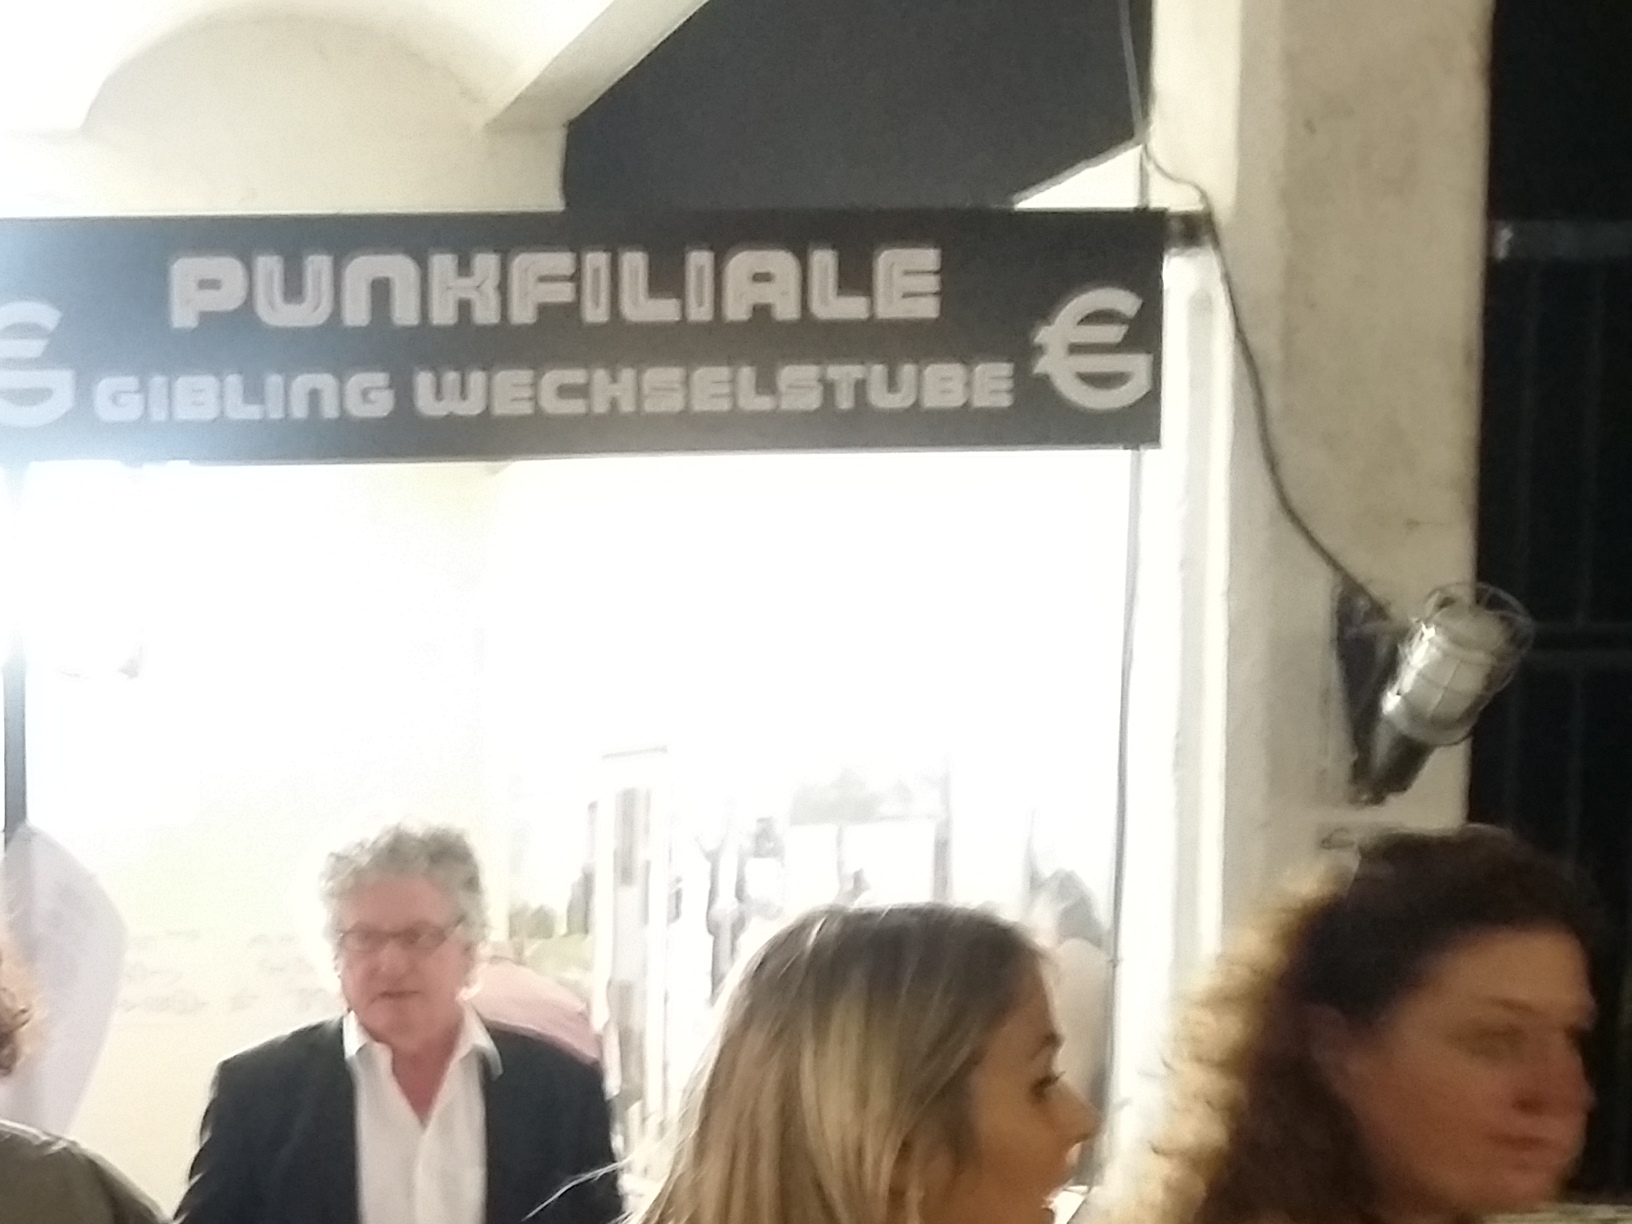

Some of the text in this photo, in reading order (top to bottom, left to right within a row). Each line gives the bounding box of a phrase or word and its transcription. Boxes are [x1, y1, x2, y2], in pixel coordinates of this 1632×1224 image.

[171, 249, 942, 328] PUNKFILIALE
[95, 363, 1015, 421] GIBLING WECHSELSTUBE
